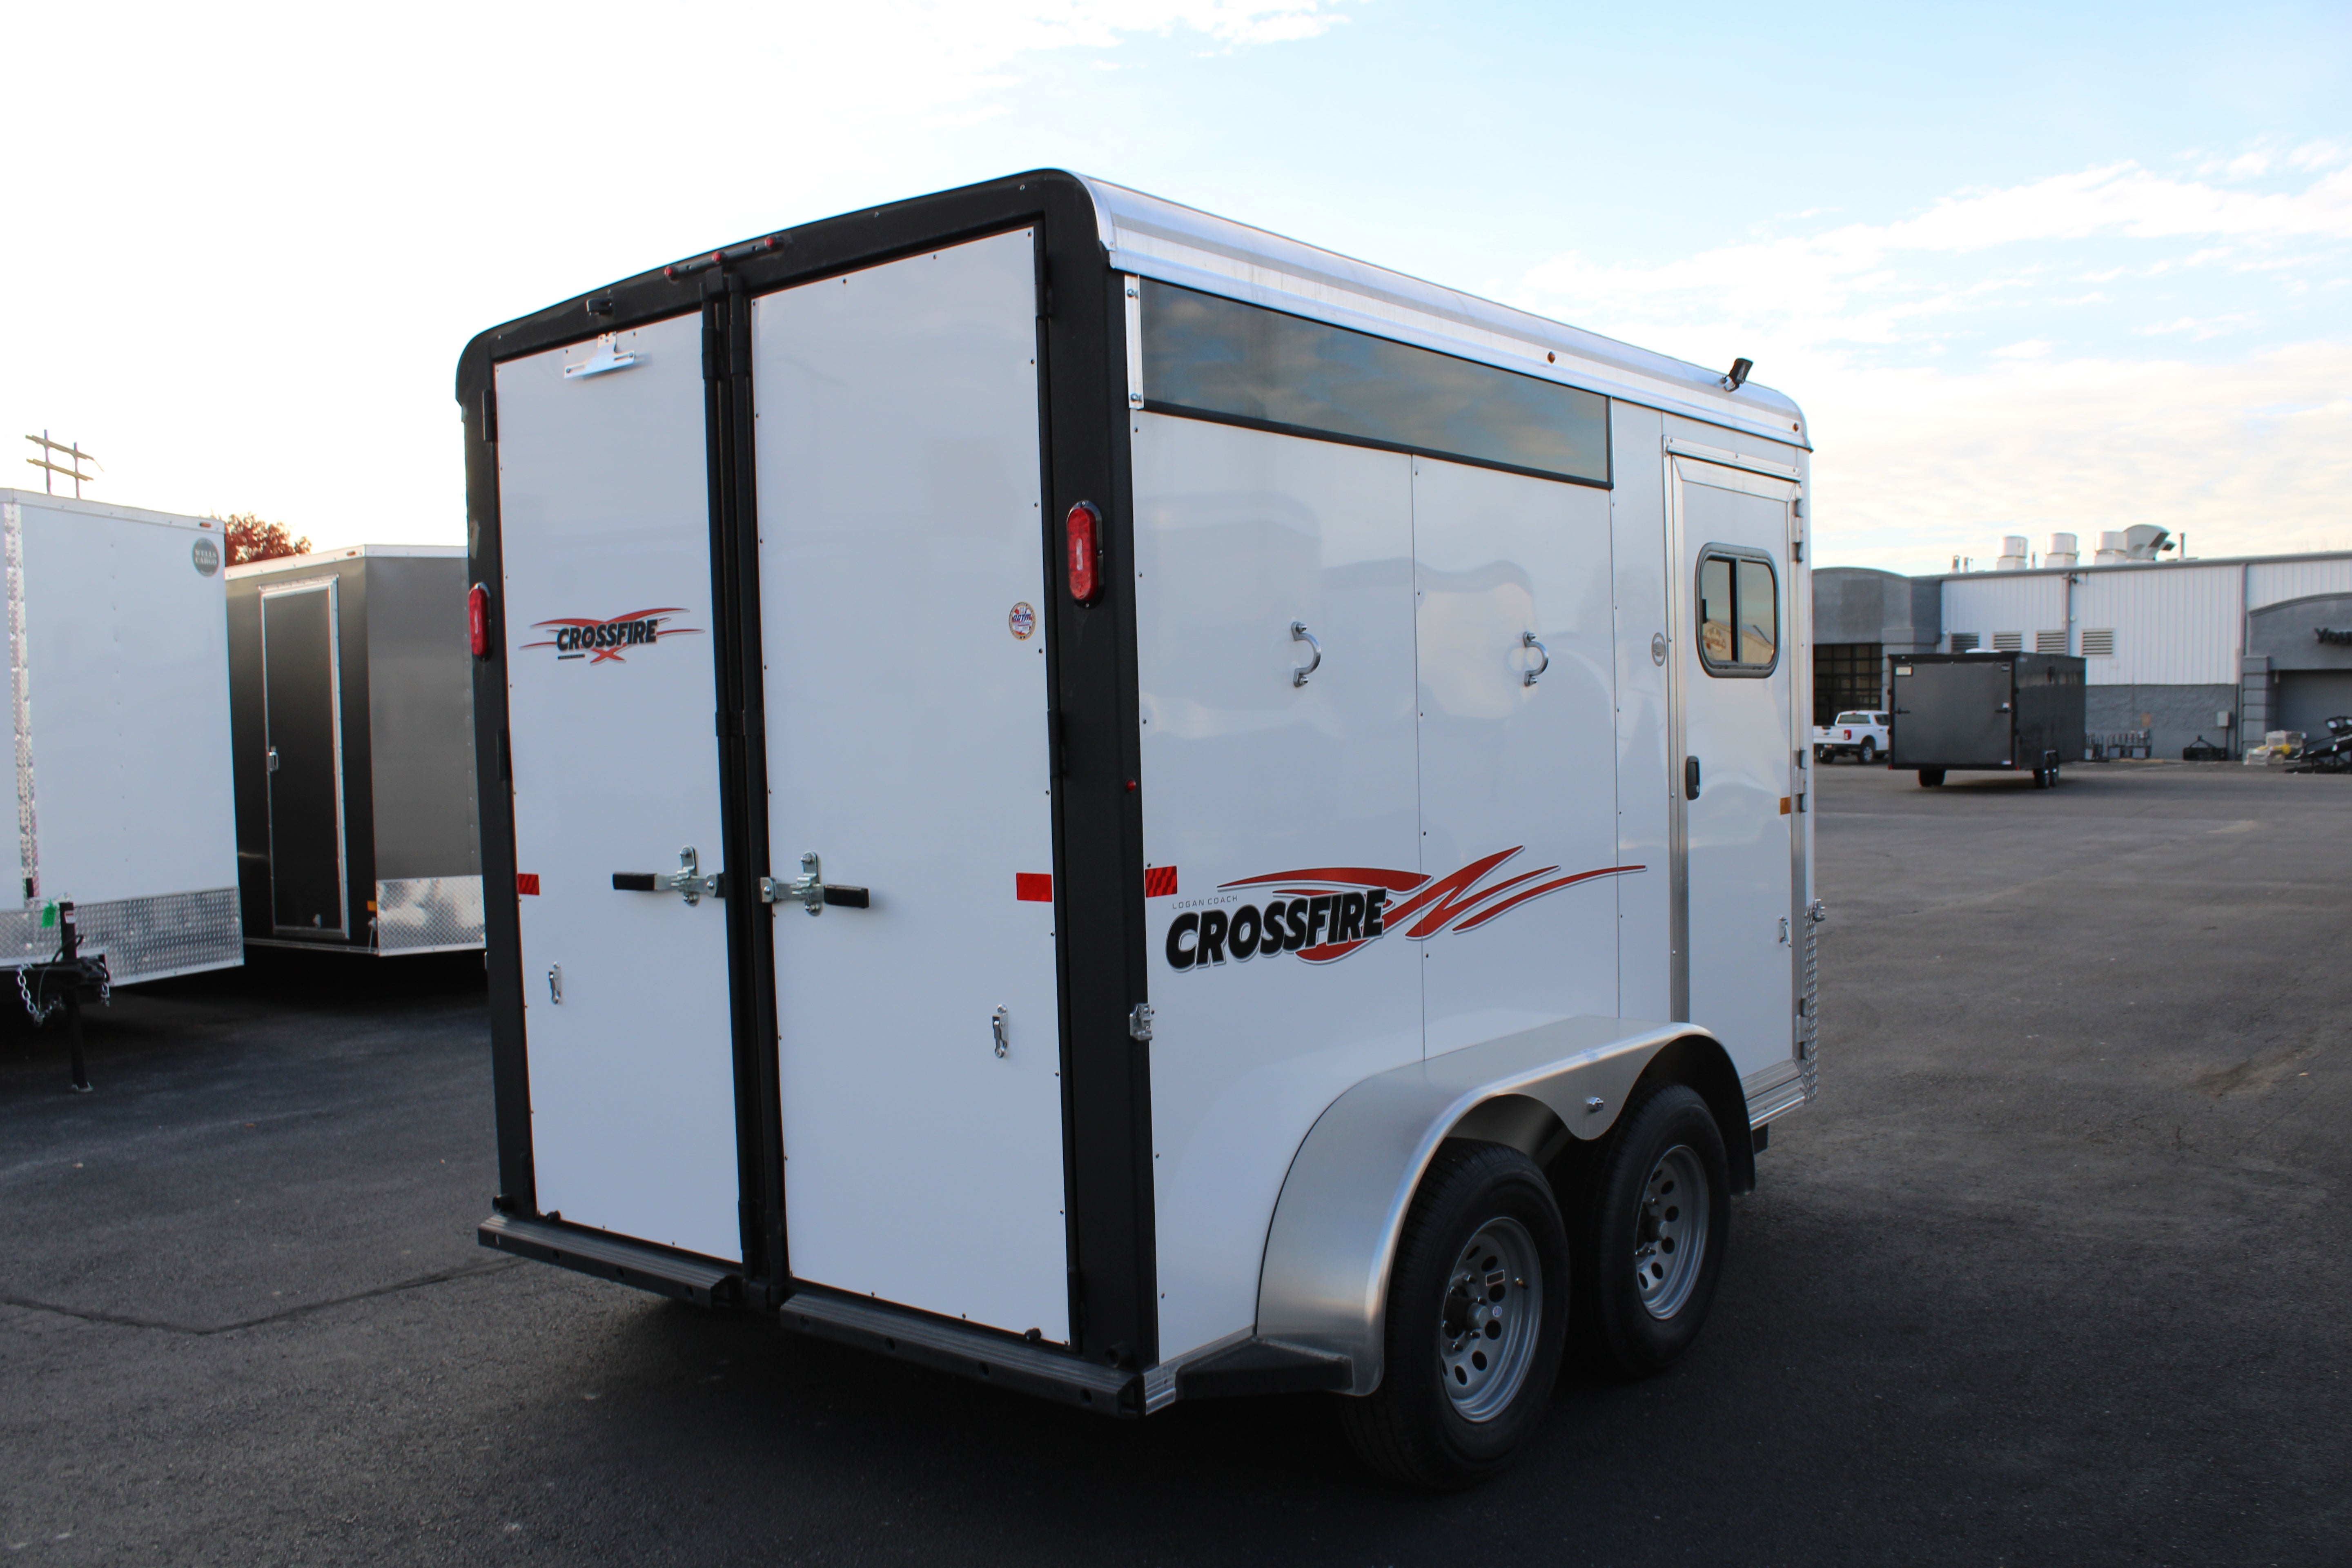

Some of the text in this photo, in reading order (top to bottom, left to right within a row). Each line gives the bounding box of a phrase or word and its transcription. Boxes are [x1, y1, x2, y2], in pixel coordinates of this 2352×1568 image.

[195, 549, 217, 558] WELLS
[195, 556, 217, 565] CARGO
[557, 619, 658, 652] CROSSFIRE
[1172, 895, 1237, 909] LOGAN COACH
[1165, 887, 1388, 971] CROSSFIRE
